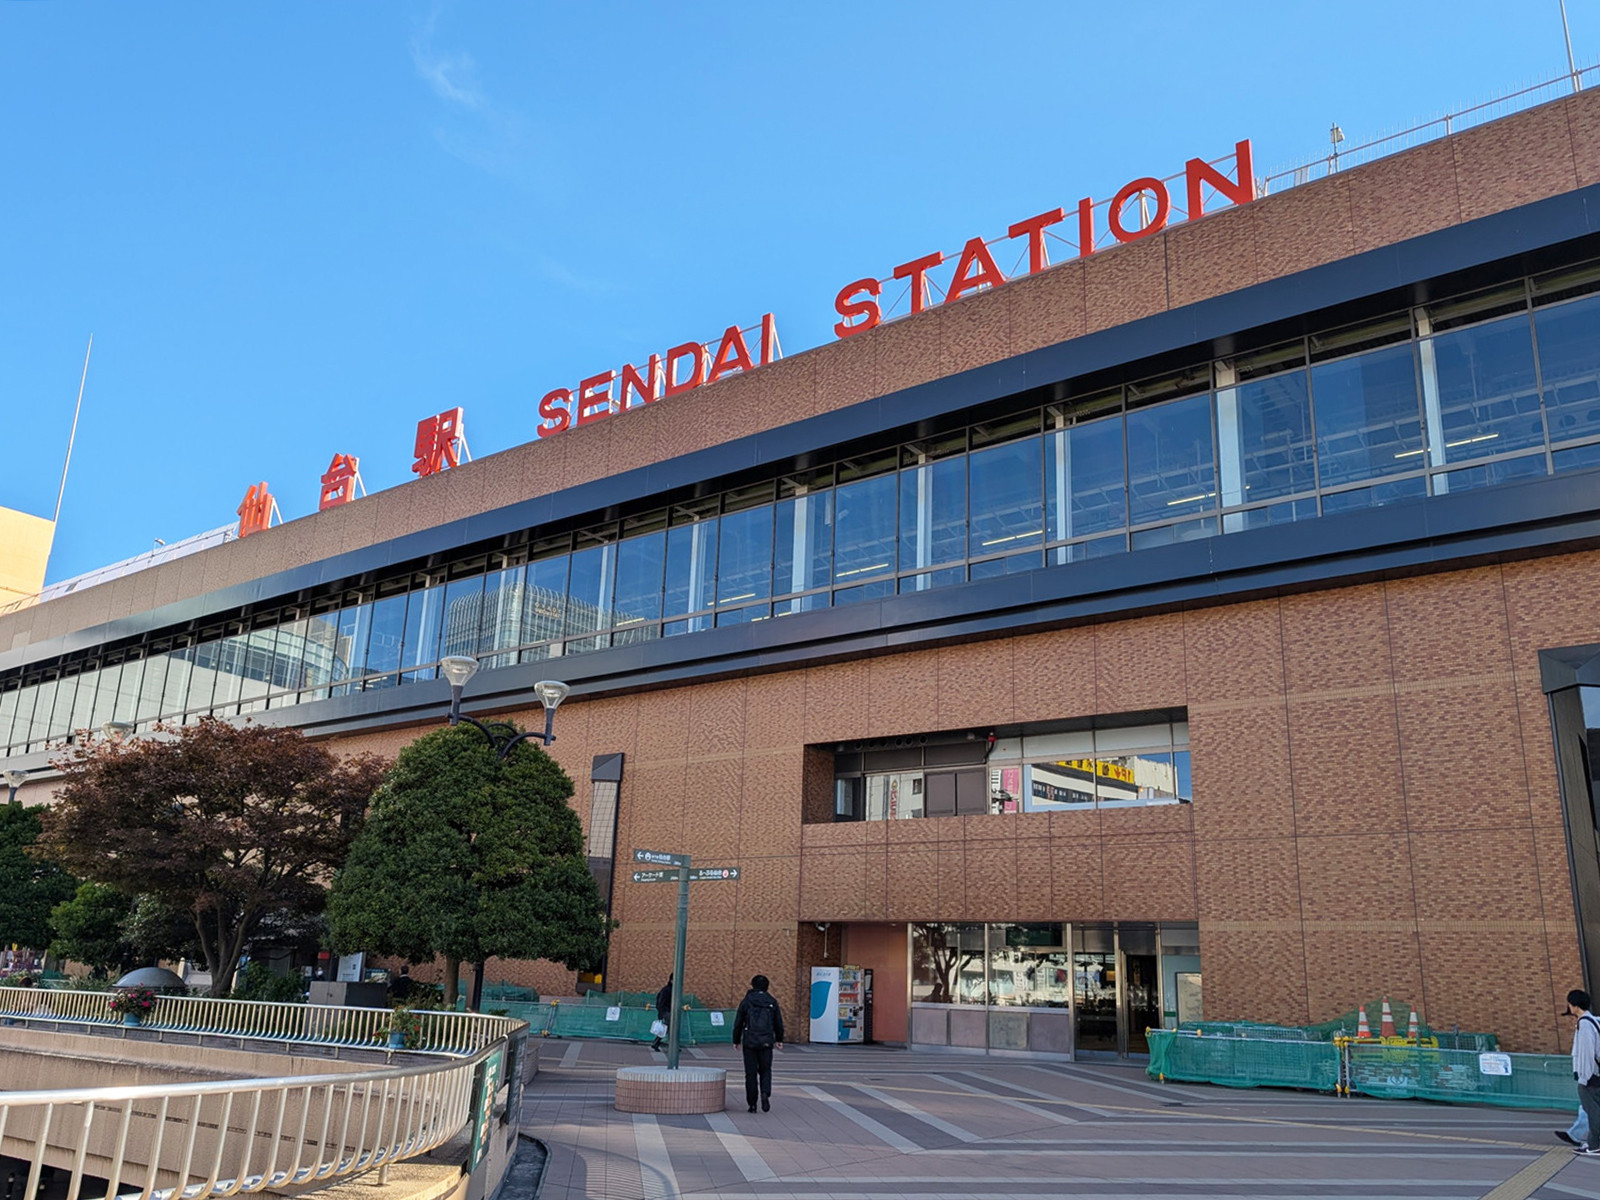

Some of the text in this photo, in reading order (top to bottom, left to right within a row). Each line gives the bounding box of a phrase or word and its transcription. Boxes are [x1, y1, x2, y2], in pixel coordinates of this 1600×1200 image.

[537, 139, 1255, 438] SENDAI STATION
[237, 406, 464, 538] 仙台駅
